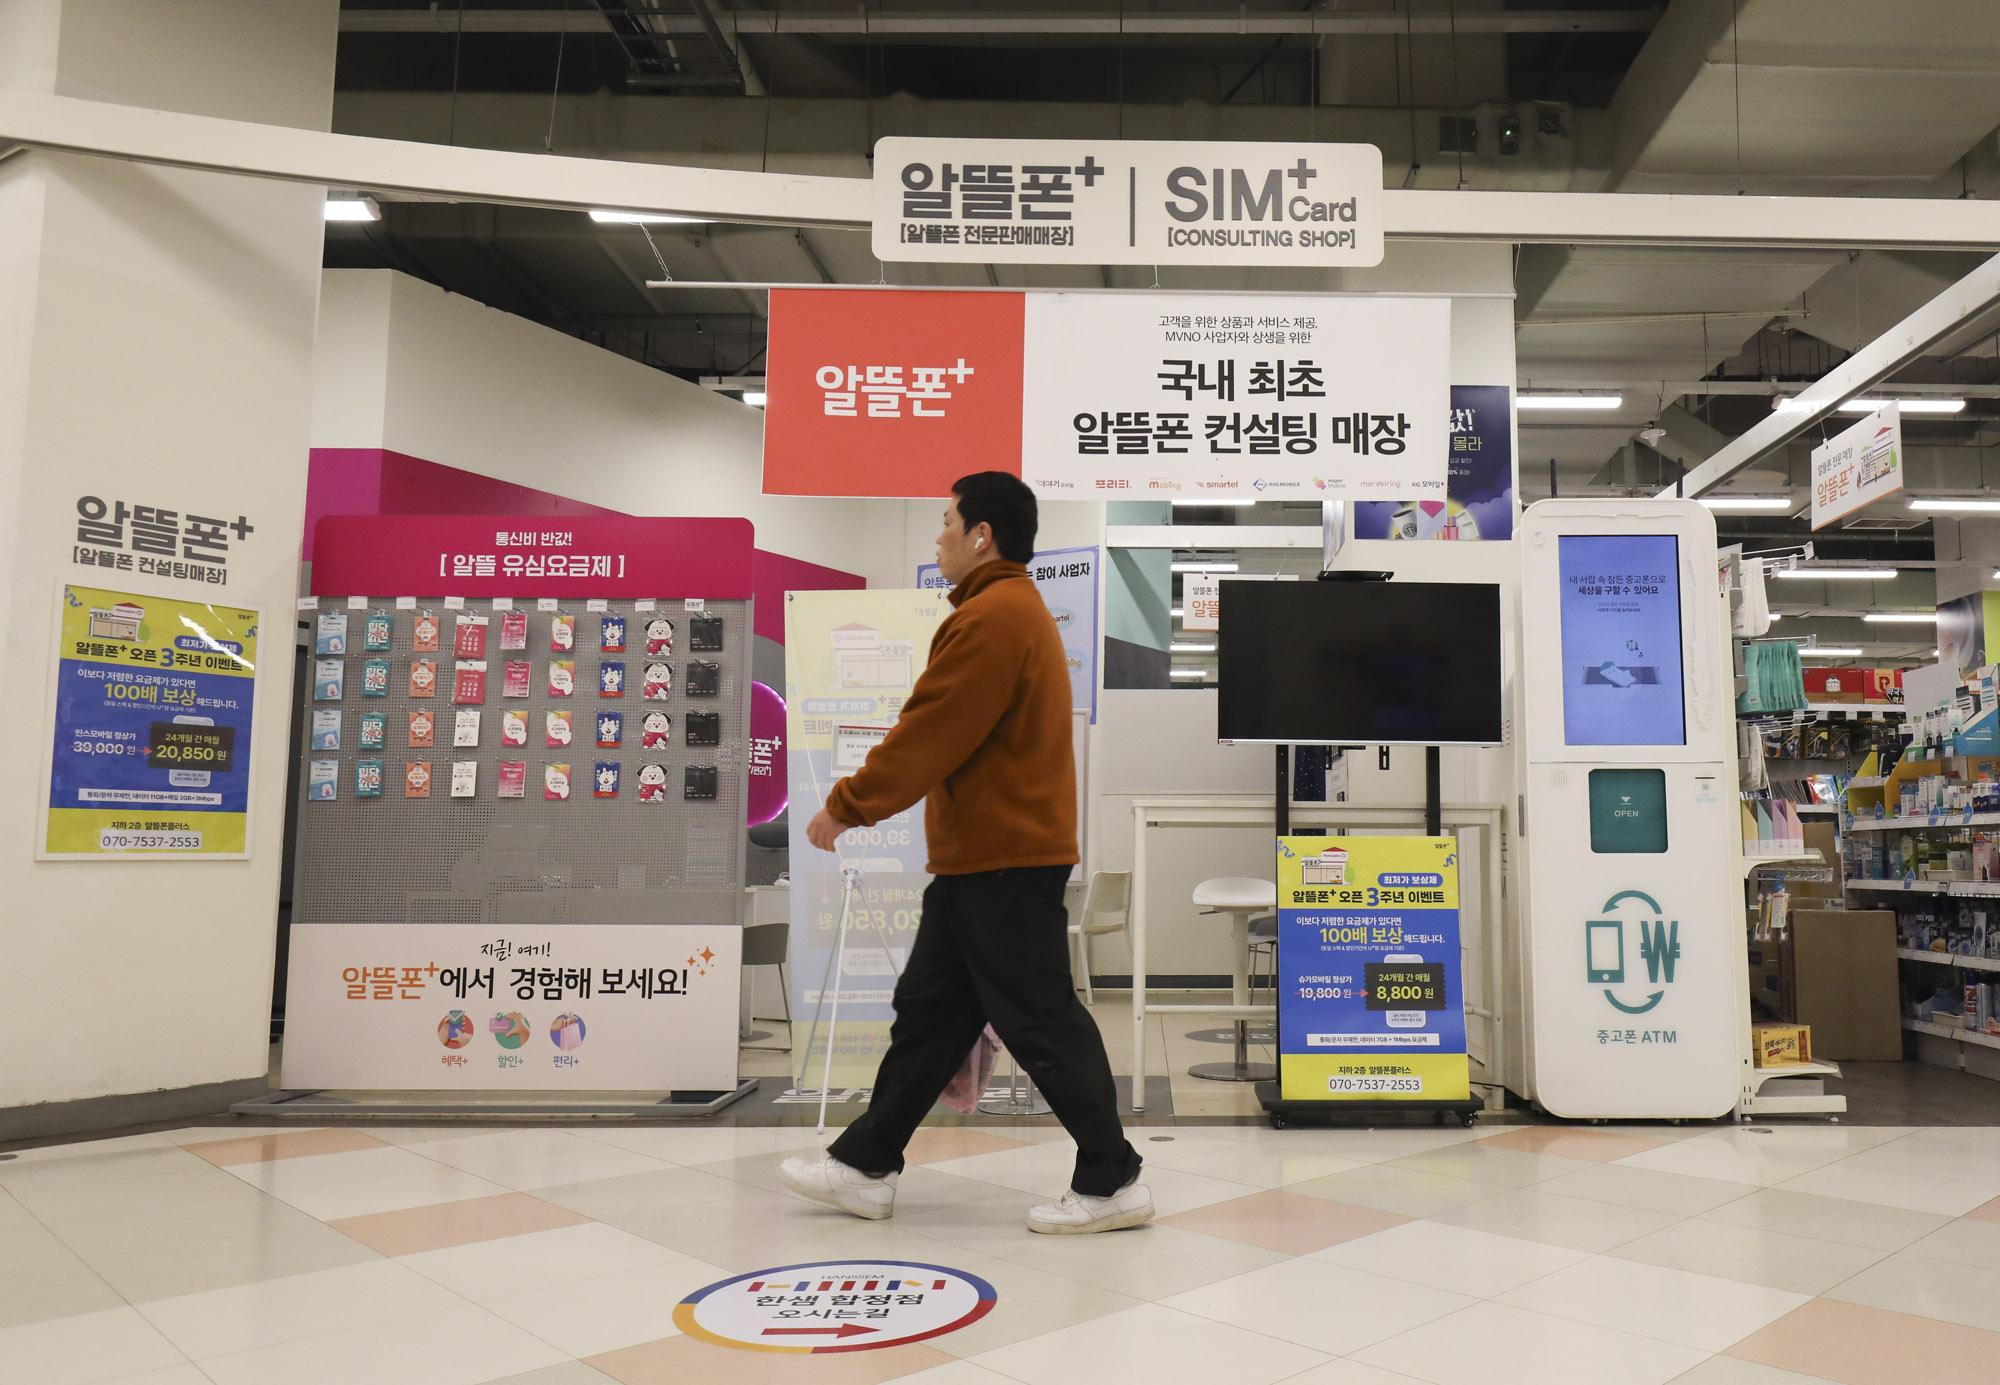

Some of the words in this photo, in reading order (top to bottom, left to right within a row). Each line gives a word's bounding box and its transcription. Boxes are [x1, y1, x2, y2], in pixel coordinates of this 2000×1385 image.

[901, 156, 1104, 220] 알뜰폰+
[1289, 196, 1357, 222] Card
[900, 223, 960, 244] [알뜰폰
[964, 225, 1074, 246] 전문판매매장]
[1168, 227, 1292, 248] [CONSULTING
[1299, 229, 1355, 249] SHOP]
[1158, 315, 1192, 329] 고객을
[1194, 315, 1217, 329] 위한
[1220, 315, 1255, 329] 상품과
[1258, 316, 1290, 329] 서비스
[1293, 316, 1318, 330] 제공,
[1165, 331, 1201, 343] MVNO
[1203, 331, 1250, 344] 사업자와
[1252, 331, 1286, 344] 상생을
[1288, 331, 1312, 345] 위한
[816, 357, 974, 418] 알뜰폰+
[1157, 359, 1235, 402] 국내
[1248, 359, 1326, 402] 최초
[1073, 411, 1193, 455] 알뜰폰
[1204, 412, 1318, 455] 컨설팅
[1332, 412, 1412, 456] 매장
[1453, 436, 1483, 451] 몰라
[1149, 480, 1182, 490] mobing
[1206, 480, 1239, 489] smartel
[1817, 462, 1855, 508] 알뜰폰+
[76, 495, 254, 565] 알뜰폰+
[495, 532, 537, 546] 통신비
[540, 532, 572, 547] 반값!
[73, 546, 133, 571] [알뜰폰
[138, 557, 227, 586] 컨설팅매장]
[453, 554, 497, 577] 알뜰
[502, 554, 611, 577] 유심요금제
[1036, 566, 1056, 581] 참여
[1059, 562, 1090, 579] 사업자
[1569, 576, 1578, 584] 내
[1581, 575, 1596, 584] 서랍
[1597, 575, 1606, 584] 속
[1607, 575, 1624, 585] 잠든
[1625, 575, 1667, 584] 중고폰으로
[1578, 586, 1602, 595] 세상을
[1604, 586, 1620, 595] 구할
[1622, 586, 1631, 595] 수
[1634, 586, 1659, 595] 있어요
[76, 641, 127, 659] 알뜰폰+
[130, 648, 157, 662] 오픈
[160, 647, 202, 667] 3주년
[205, 656, 243, 671] 이벤트
[78, 669, 105, 679] 이보다
[107, 672, 134, 683] 저렴한
[136, 675, 169, 687] 요금제가
[171, 678, 196, 688] 있다면
[104, 683, 158, 703] 100배
[162, 689, 196, 706] 보상
[196, 697, 239, 710] 해드립니다.
[114, 731, 136, 741] 정상가
[165, 733, 192, 744] 24개월
[194, 735, 203, 744] 간
[204, 735, 219, 745] 매월
[73, 741, 124, 756] 39,000
[127, 745, 136, 756] 원
[156, 744, 214, 762] 20,850
[216, 750, 227, 761] 원
[111, 821, 127, 830] 지하
[129, 821, 142, 830] 2층
[145, 821, 190, 830] 알뜰폰플러스
[103, 836, 200, 848] 070-7537-2553
[1383, 875, 1409, 885] 최저가
[1411, 875, 1438, 885] 보상제
[1292, 889, 1337, 903] 알뜰폰+
[1339, 891, 1363, 903] 오픈
[1366, 887, 1404, 907] 3주년
[1408, 890, 1444, 903] 이벤트
[1296, 916, 1320, 926] 이보다
[1321, 916, 1345, 926] 저렴한
[1346, 916, 1377, 926] 요금제가
[1378, 916, 1402, 926] 있다면
[1320, 926, 1368, 944] 100배
[1372, 926, 1403, 944] 보상
[1404, 934, 1445, 944] 해드립니다.
[480, 939, 512, 961] 지금!
[517, 942, 551, 958] 여기!
[509, 967, 592, 1001] 경험해
[598, 967, 688, 1000] 보세요!
[1299, 975, 1331, 984] 슈가모바일
[1332, 975, 1352, 984] 정상가
[1378, 973, 1404, 983] 24개월
[1405, 973, 1414, 983] 간
[1415, 973, 1431, 983] 매월
[1299, 987, 1341, 1001] 19,800
[1343, 988, 1352, 999] 원
[1376, 986, 1422, 1003] 8,800
[1424, 988, 1434, 999] 원
[1597, 1030, 1637, 1044] 중고폰
[1641, 1030, 1677, 1044] ATM
[1339, 1066, 1353, 1075] 지하
[1354, 1066, 1366, 1075] 2층
[1369, 1066, 1412, 1075] 알뜰폰플러스
[1329, 1079, 1420, 1091] 070-7537-2553
[756, 1294, 820, 1307] 한샘
[831, 1293, 925, 1306] 합정점
[772, 1308, 890, 1319] 오시는길
